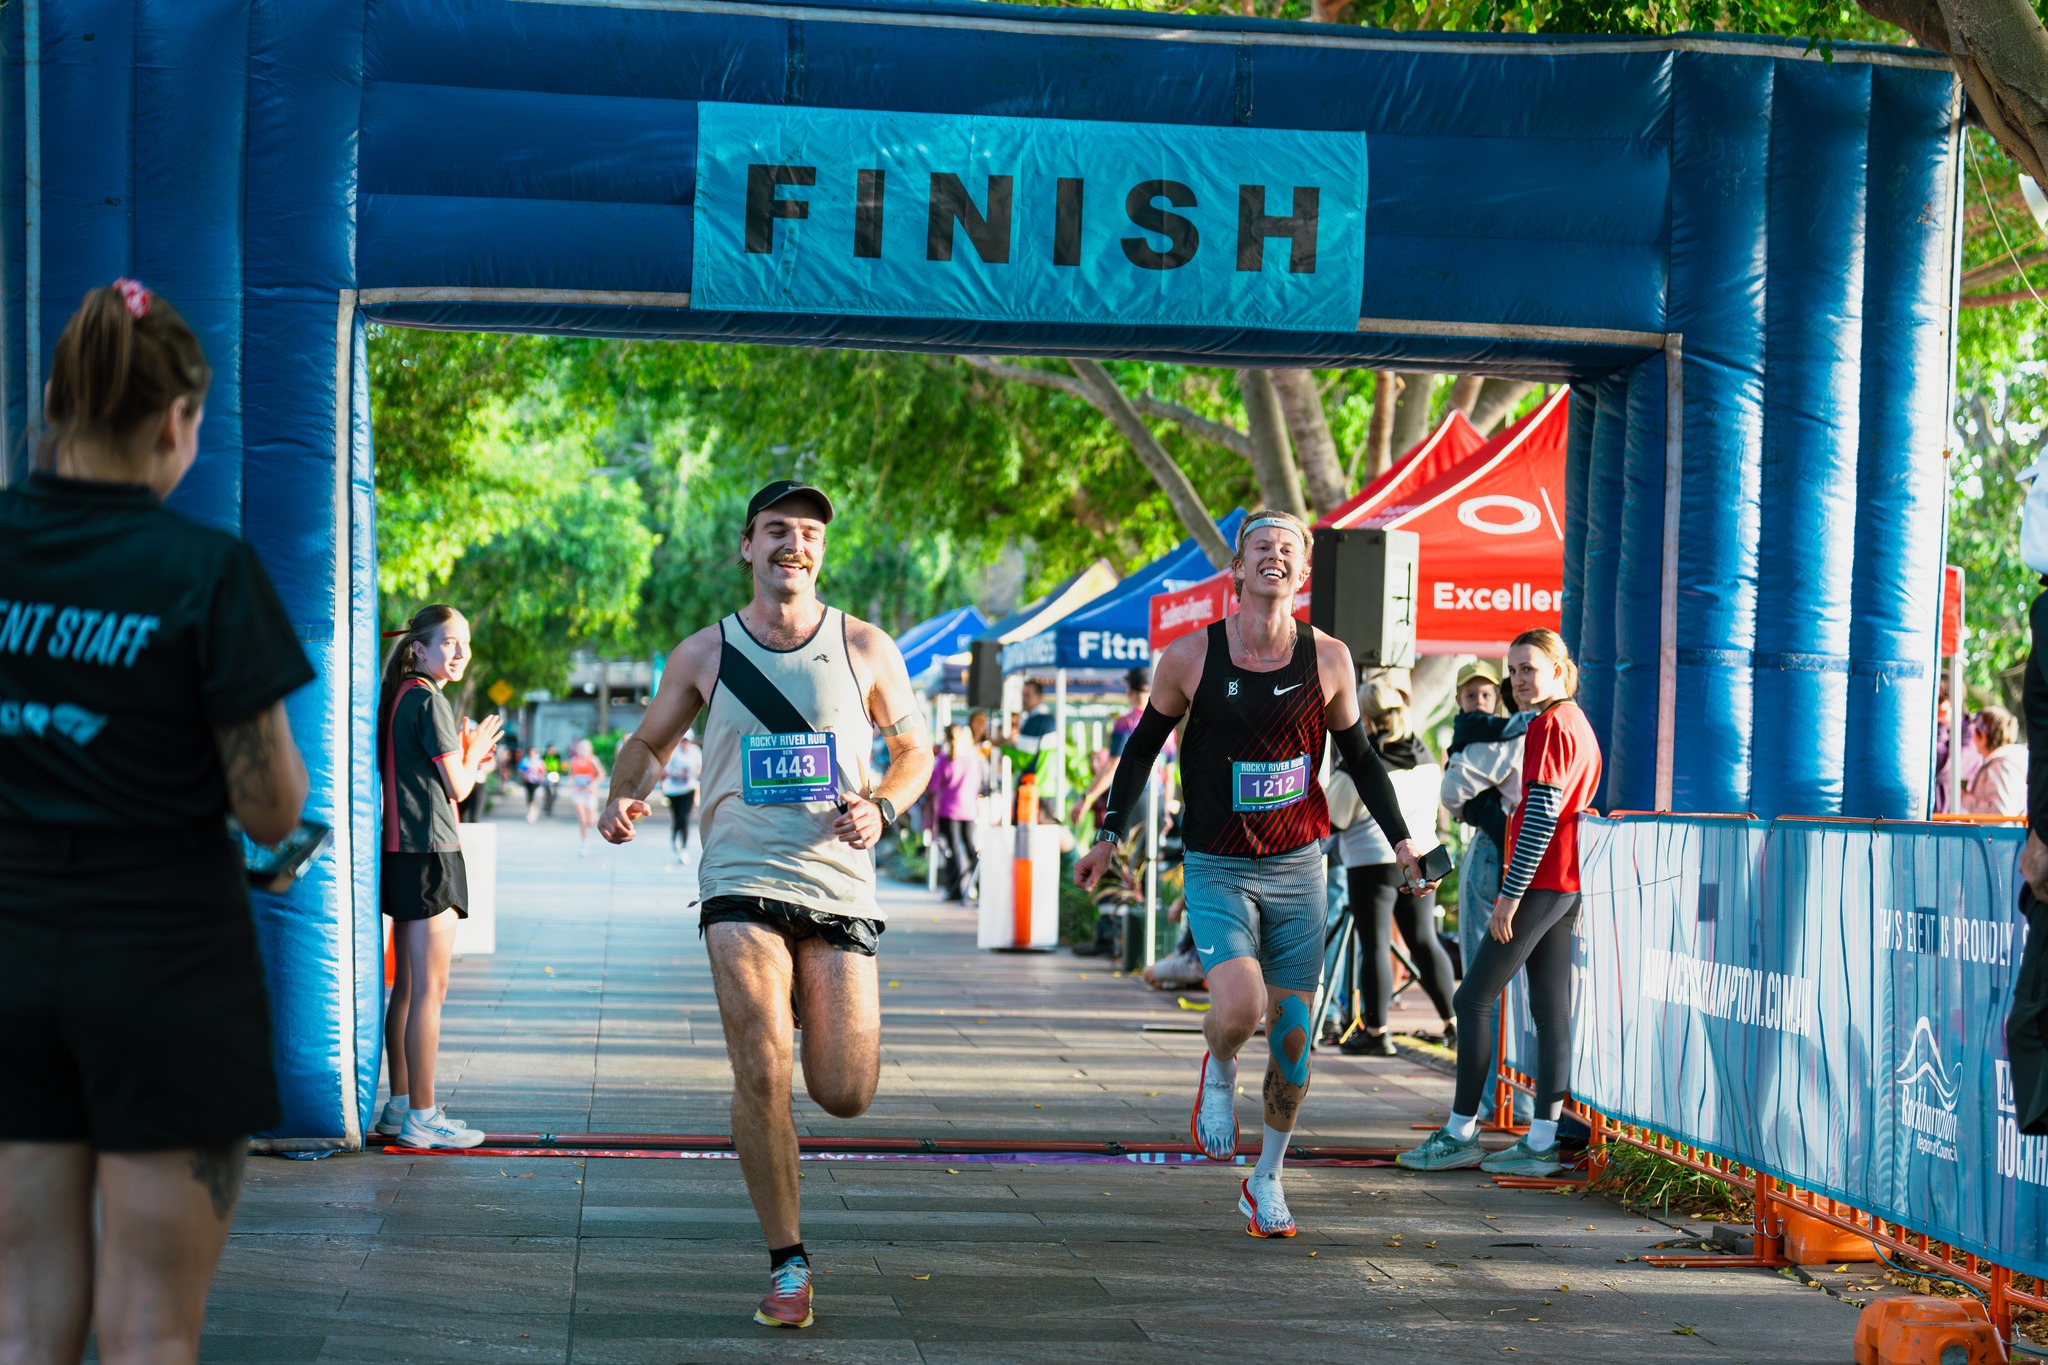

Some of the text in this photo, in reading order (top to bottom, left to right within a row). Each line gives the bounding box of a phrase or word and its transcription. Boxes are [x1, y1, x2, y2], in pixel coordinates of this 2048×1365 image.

[744, 163, 1321, 274] FINISH
[47, 604, 161, 669] STAFF
[750, 733, 826, 748] ROCKY RIVER RUN
[762, 755, 816, 779] 1443
[1241, 763, 1266, 772] ROCKY
[1268, 761, 1290, 772] RIVER
[1252, 776, 1295, 798] 1212
[1940, 915, 1950, 959] IS
[1953, 917, 2014, 967] PROUDLY
[1997, 1114, 2048, 1188] ROCKH
